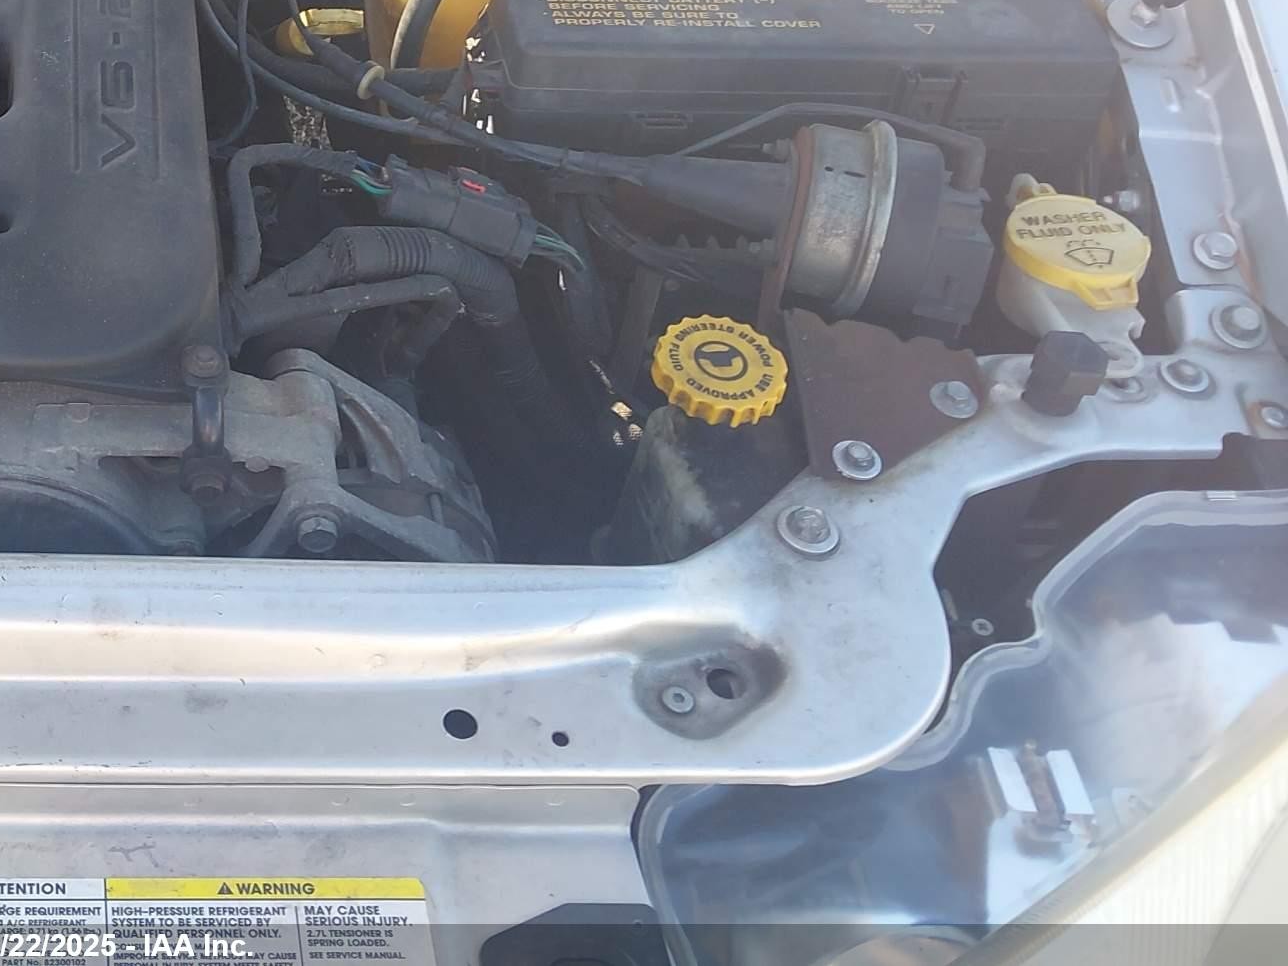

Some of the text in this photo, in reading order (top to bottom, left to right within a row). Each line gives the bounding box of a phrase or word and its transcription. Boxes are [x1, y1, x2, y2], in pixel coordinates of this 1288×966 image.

[549, 3, 720, 11] BEFORE SERVICING
[551, 11, 739, 20] ALWAYS BE SURE TO
[554, 18, 821, 28] PROPERLY RE-INSTALL COVER
[1020, 211, 1107, 227] WASHER
[1016, 223, 1126, 240] FLUID ONLY
[678, 323, 735, 342] STEERING
[739, 331, 774, 368] POWER
[668, 342, 684, 372] FLUID
[686, 377, 756, 401] APPROVED
[237, 883, 315, 895] WARNING
[24, 907, 102, 916] REQUIREMENT
[111, 907, 286, 916] HIGH-PRESSURE REFRIGERANT
[304, 905, 380, 915] MAY CAUSE
[112, 918, 271, 927] SYSTEM TO BE SERVICED BY
[305, 916, 413, 927] SERIOUS INJURY.
[112, 929, 282, 939] QUALIFIED PERSONNEL ONLY.
